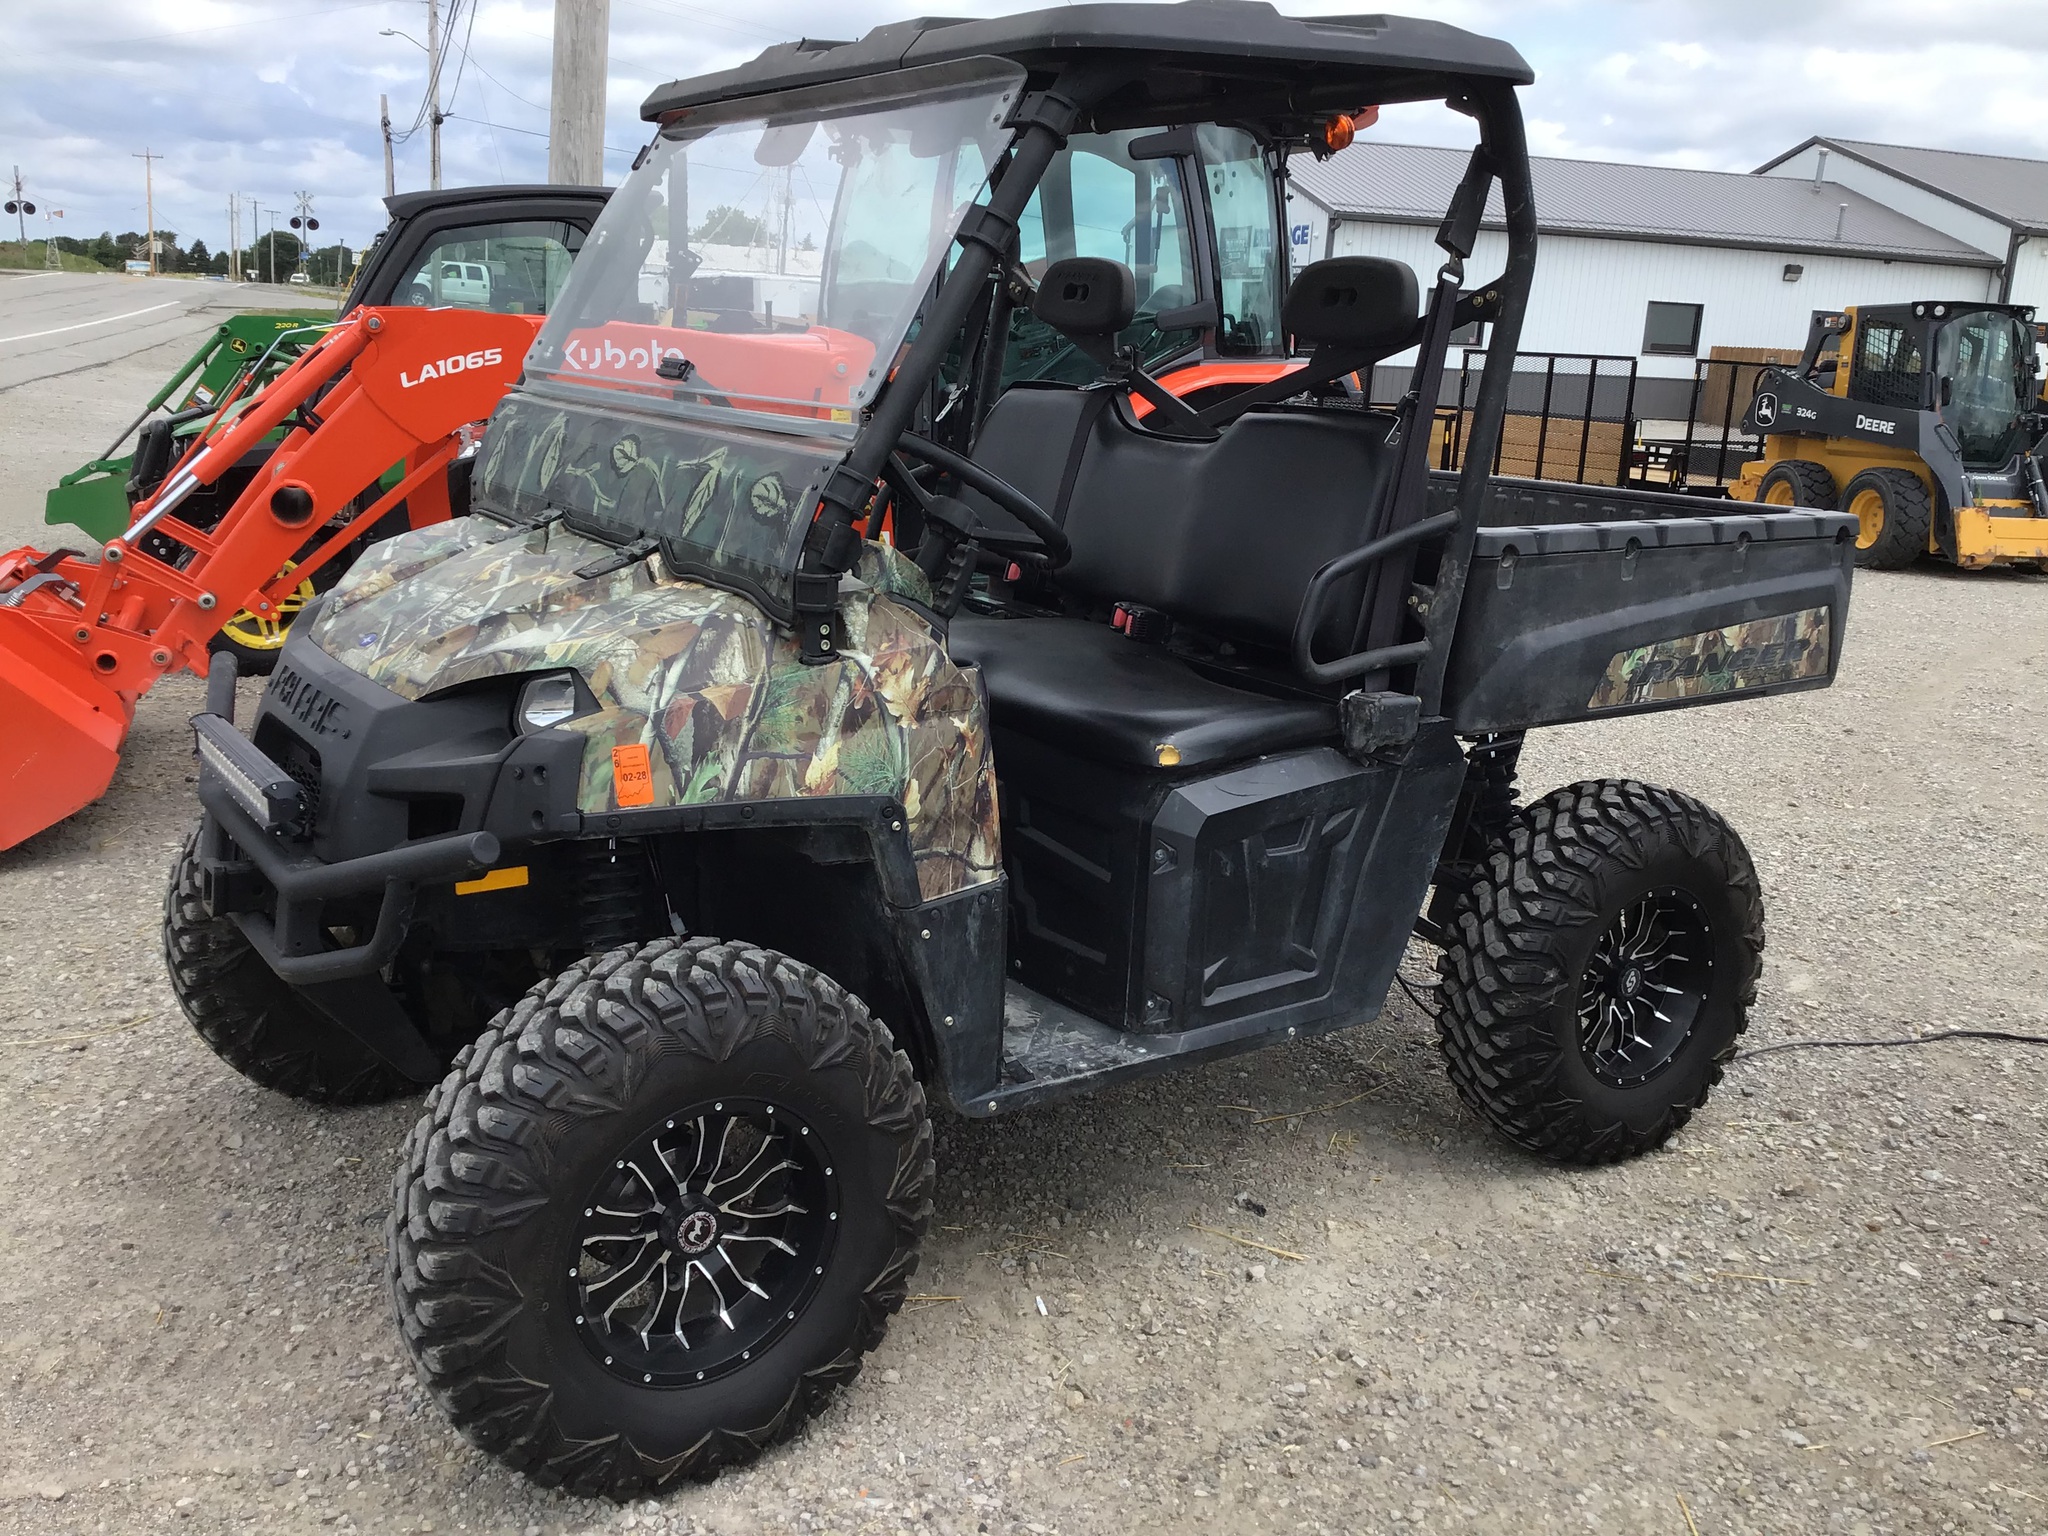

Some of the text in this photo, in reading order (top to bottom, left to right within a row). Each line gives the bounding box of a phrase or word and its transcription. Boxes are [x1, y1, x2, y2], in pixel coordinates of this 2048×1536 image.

[1291, 224, 1311, 246] GE
[400, 347, 503, 389] LA1065
[1795, 407, 1818, 420] 324G
[1855, 414, 1896, 435] DEERE
[1634, 638, 1812, 687] RANGER
[622, 770, 647, 782] 02-28
